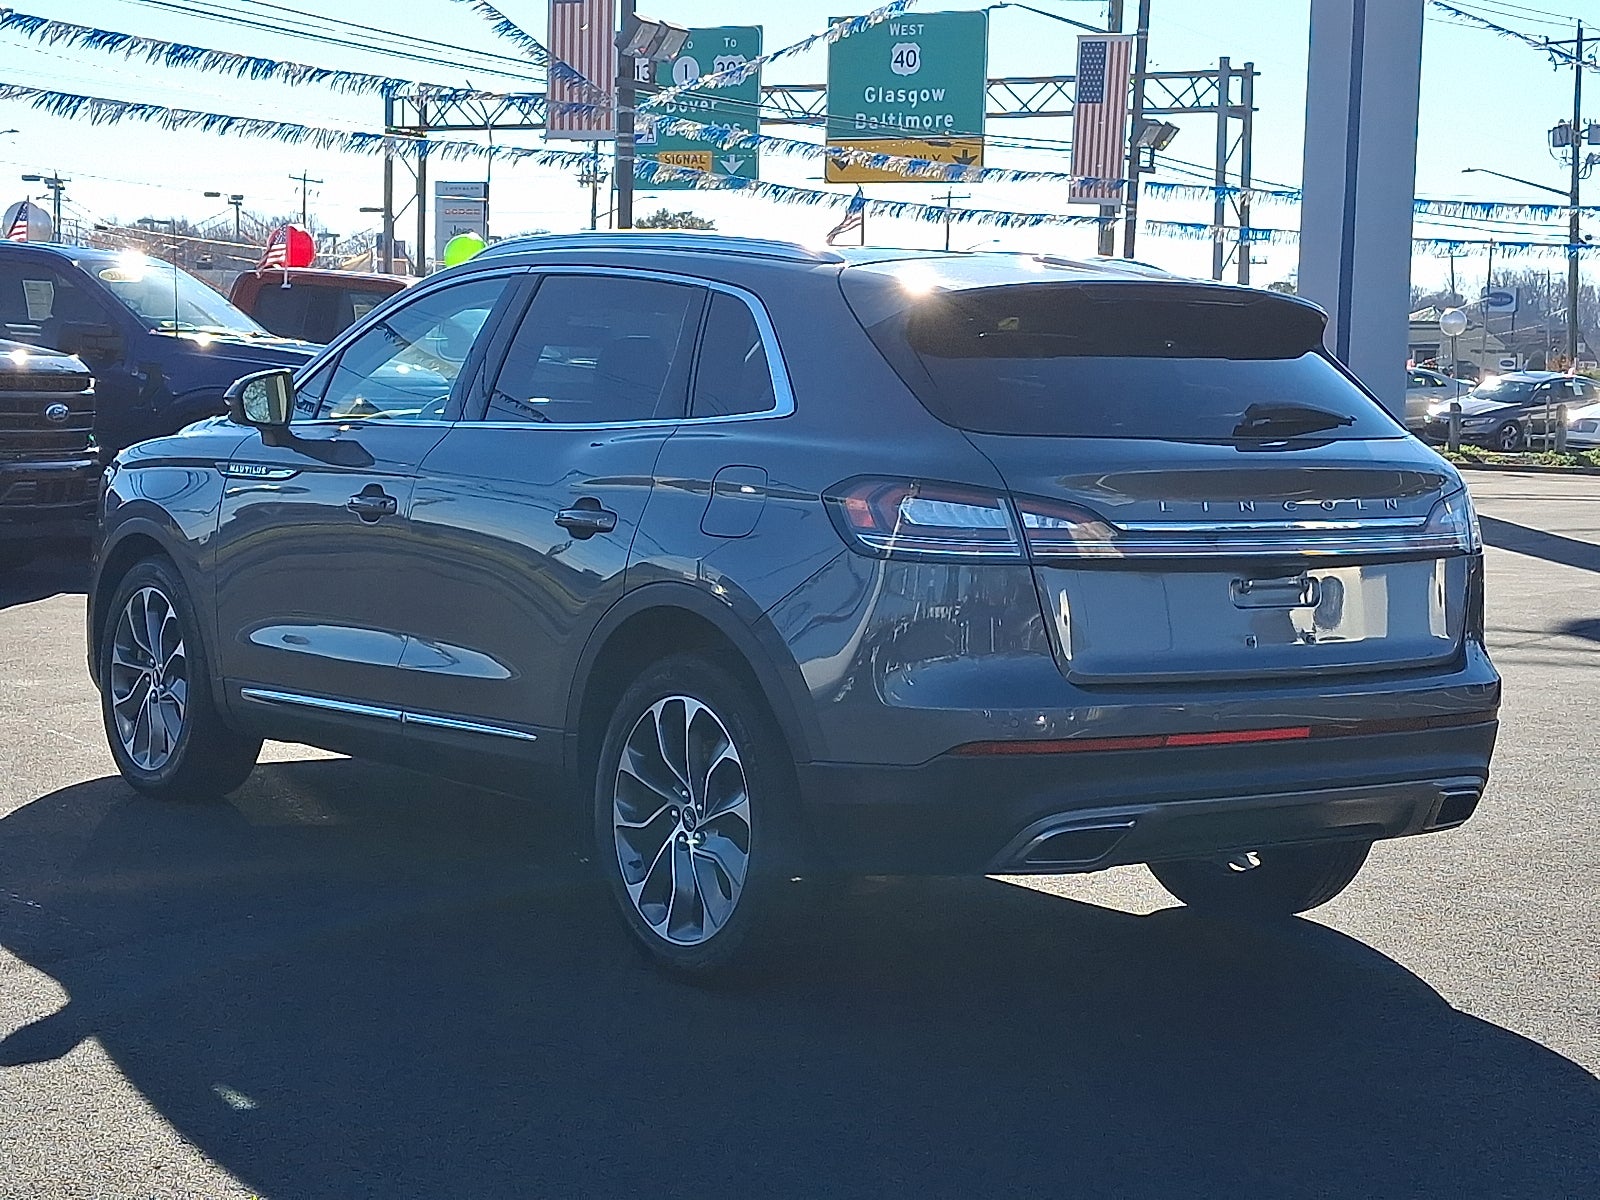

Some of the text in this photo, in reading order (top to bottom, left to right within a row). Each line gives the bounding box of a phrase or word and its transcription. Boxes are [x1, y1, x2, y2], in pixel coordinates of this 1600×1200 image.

[889, 23, 925, 36] WEST
[723, 38, 737, 48] To
[893, 49, 917, 68] 40
[636, 64, 650, 81] 13
[864, 86, 946, 109] Glasgow
[666, 100, 718, 113] Dover
[855, 112, 954, 130] Baltimore
[664, 154, 706, 165] SIGNAL
[229, 464, 267, 474] NAUTILUS
[1158, 497, 1400, 513] LINCOLN
